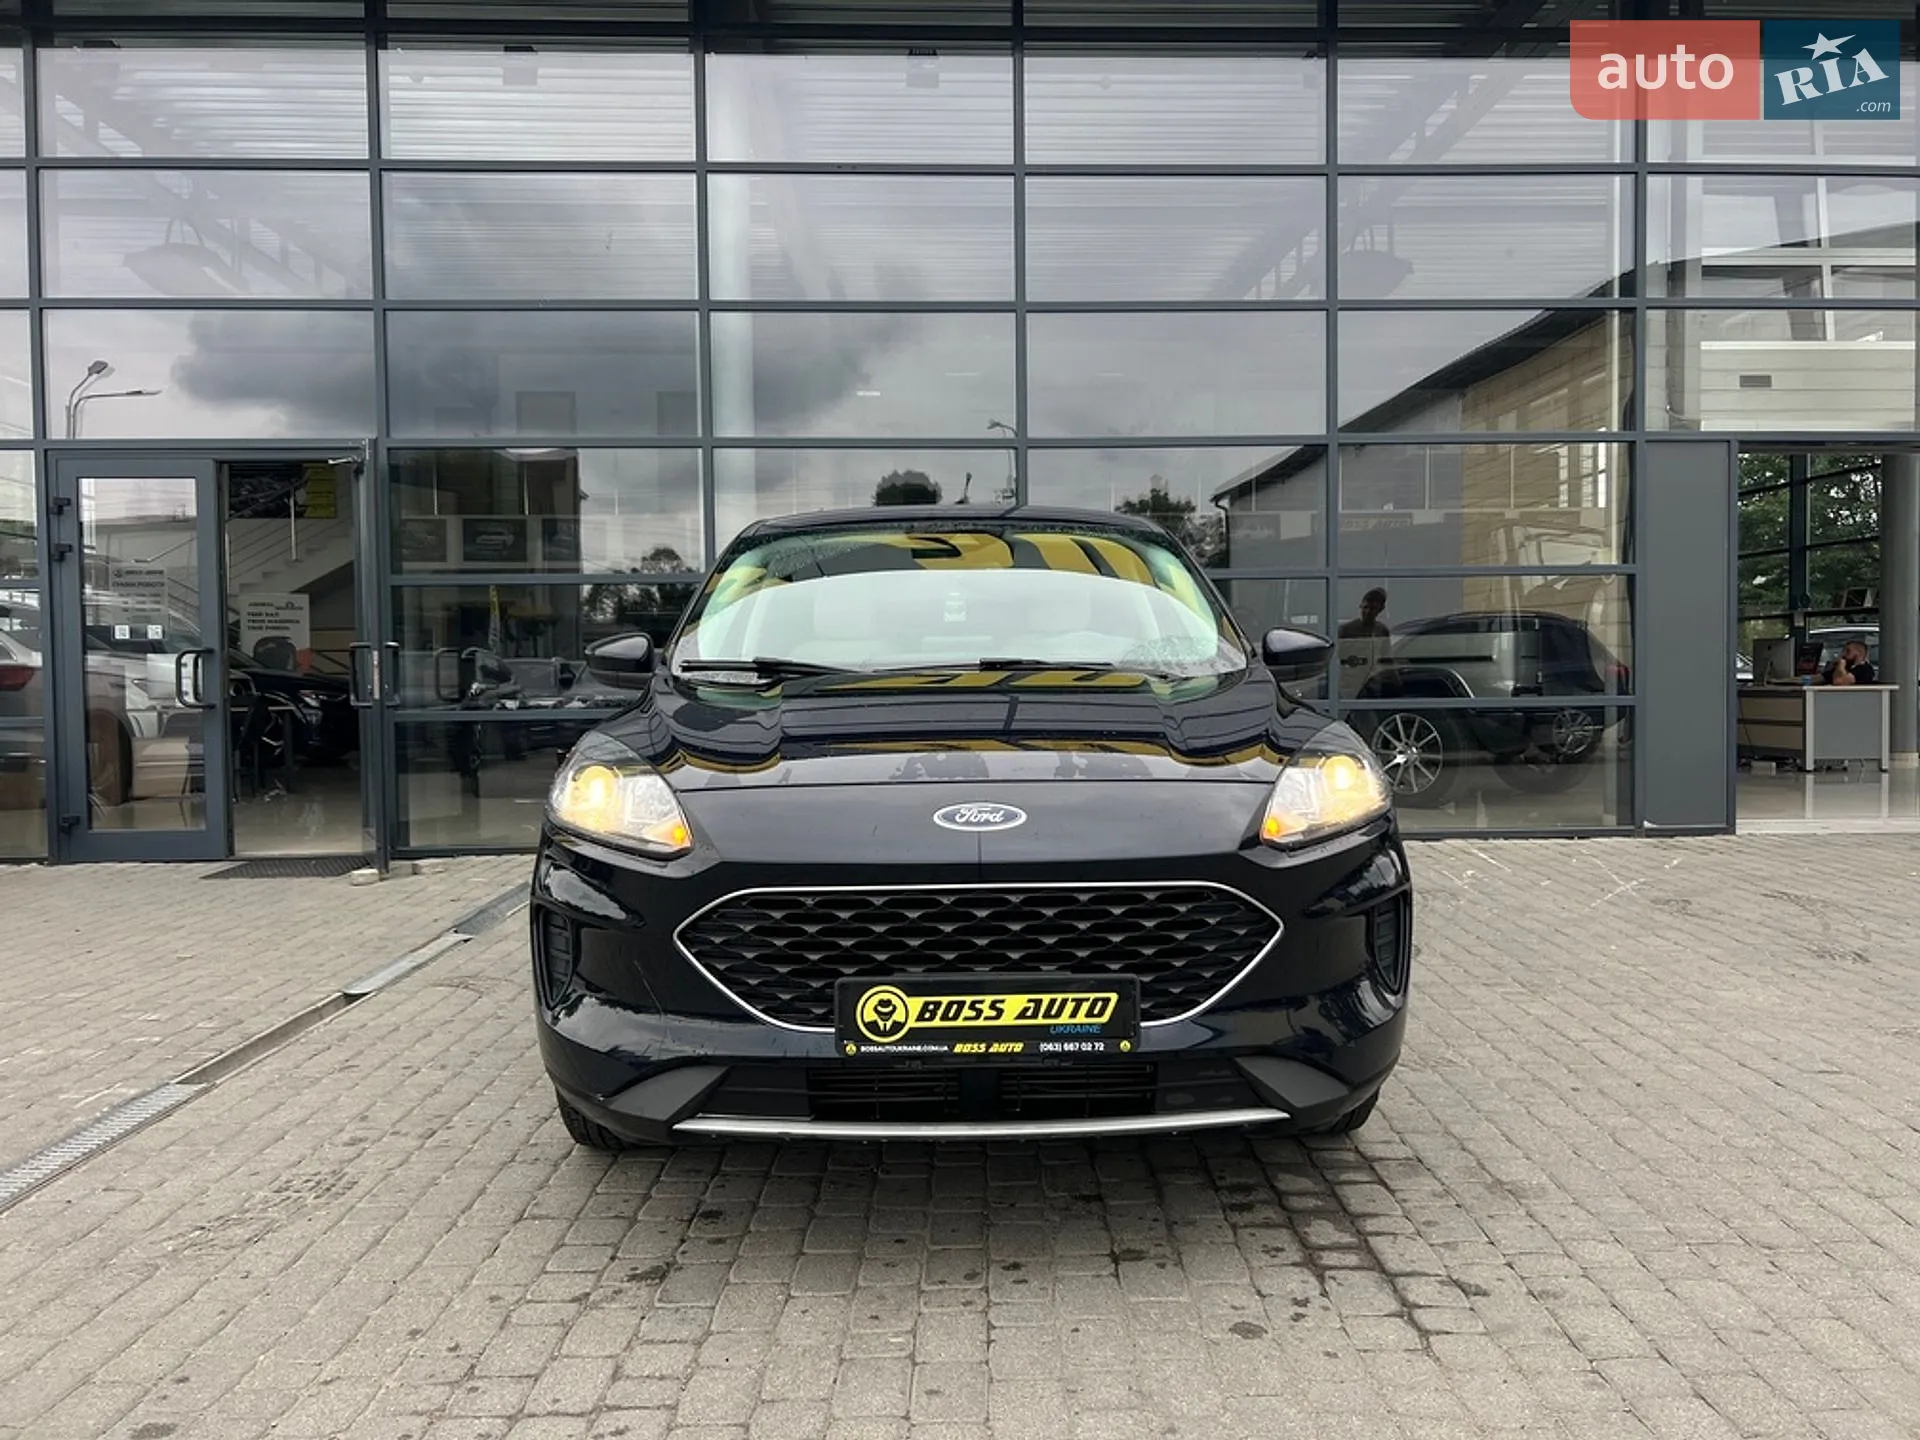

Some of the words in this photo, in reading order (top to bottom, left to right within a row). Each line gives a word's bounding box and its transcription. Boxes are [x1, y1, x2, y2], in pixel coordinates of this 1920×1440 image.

[955, 807, 1004, 823] Ford
[915, 999, 1006, 1022] BOSS
[1014, 997, 1112, 1020] AUTO
[1050, 1024, 1101, 1034] UKRAINE
[953, 1043, 986, 1053] BOSS
[988, 1042, 1025, 1053] AUTO
[1093, 1041, 1105, 1051] 72
